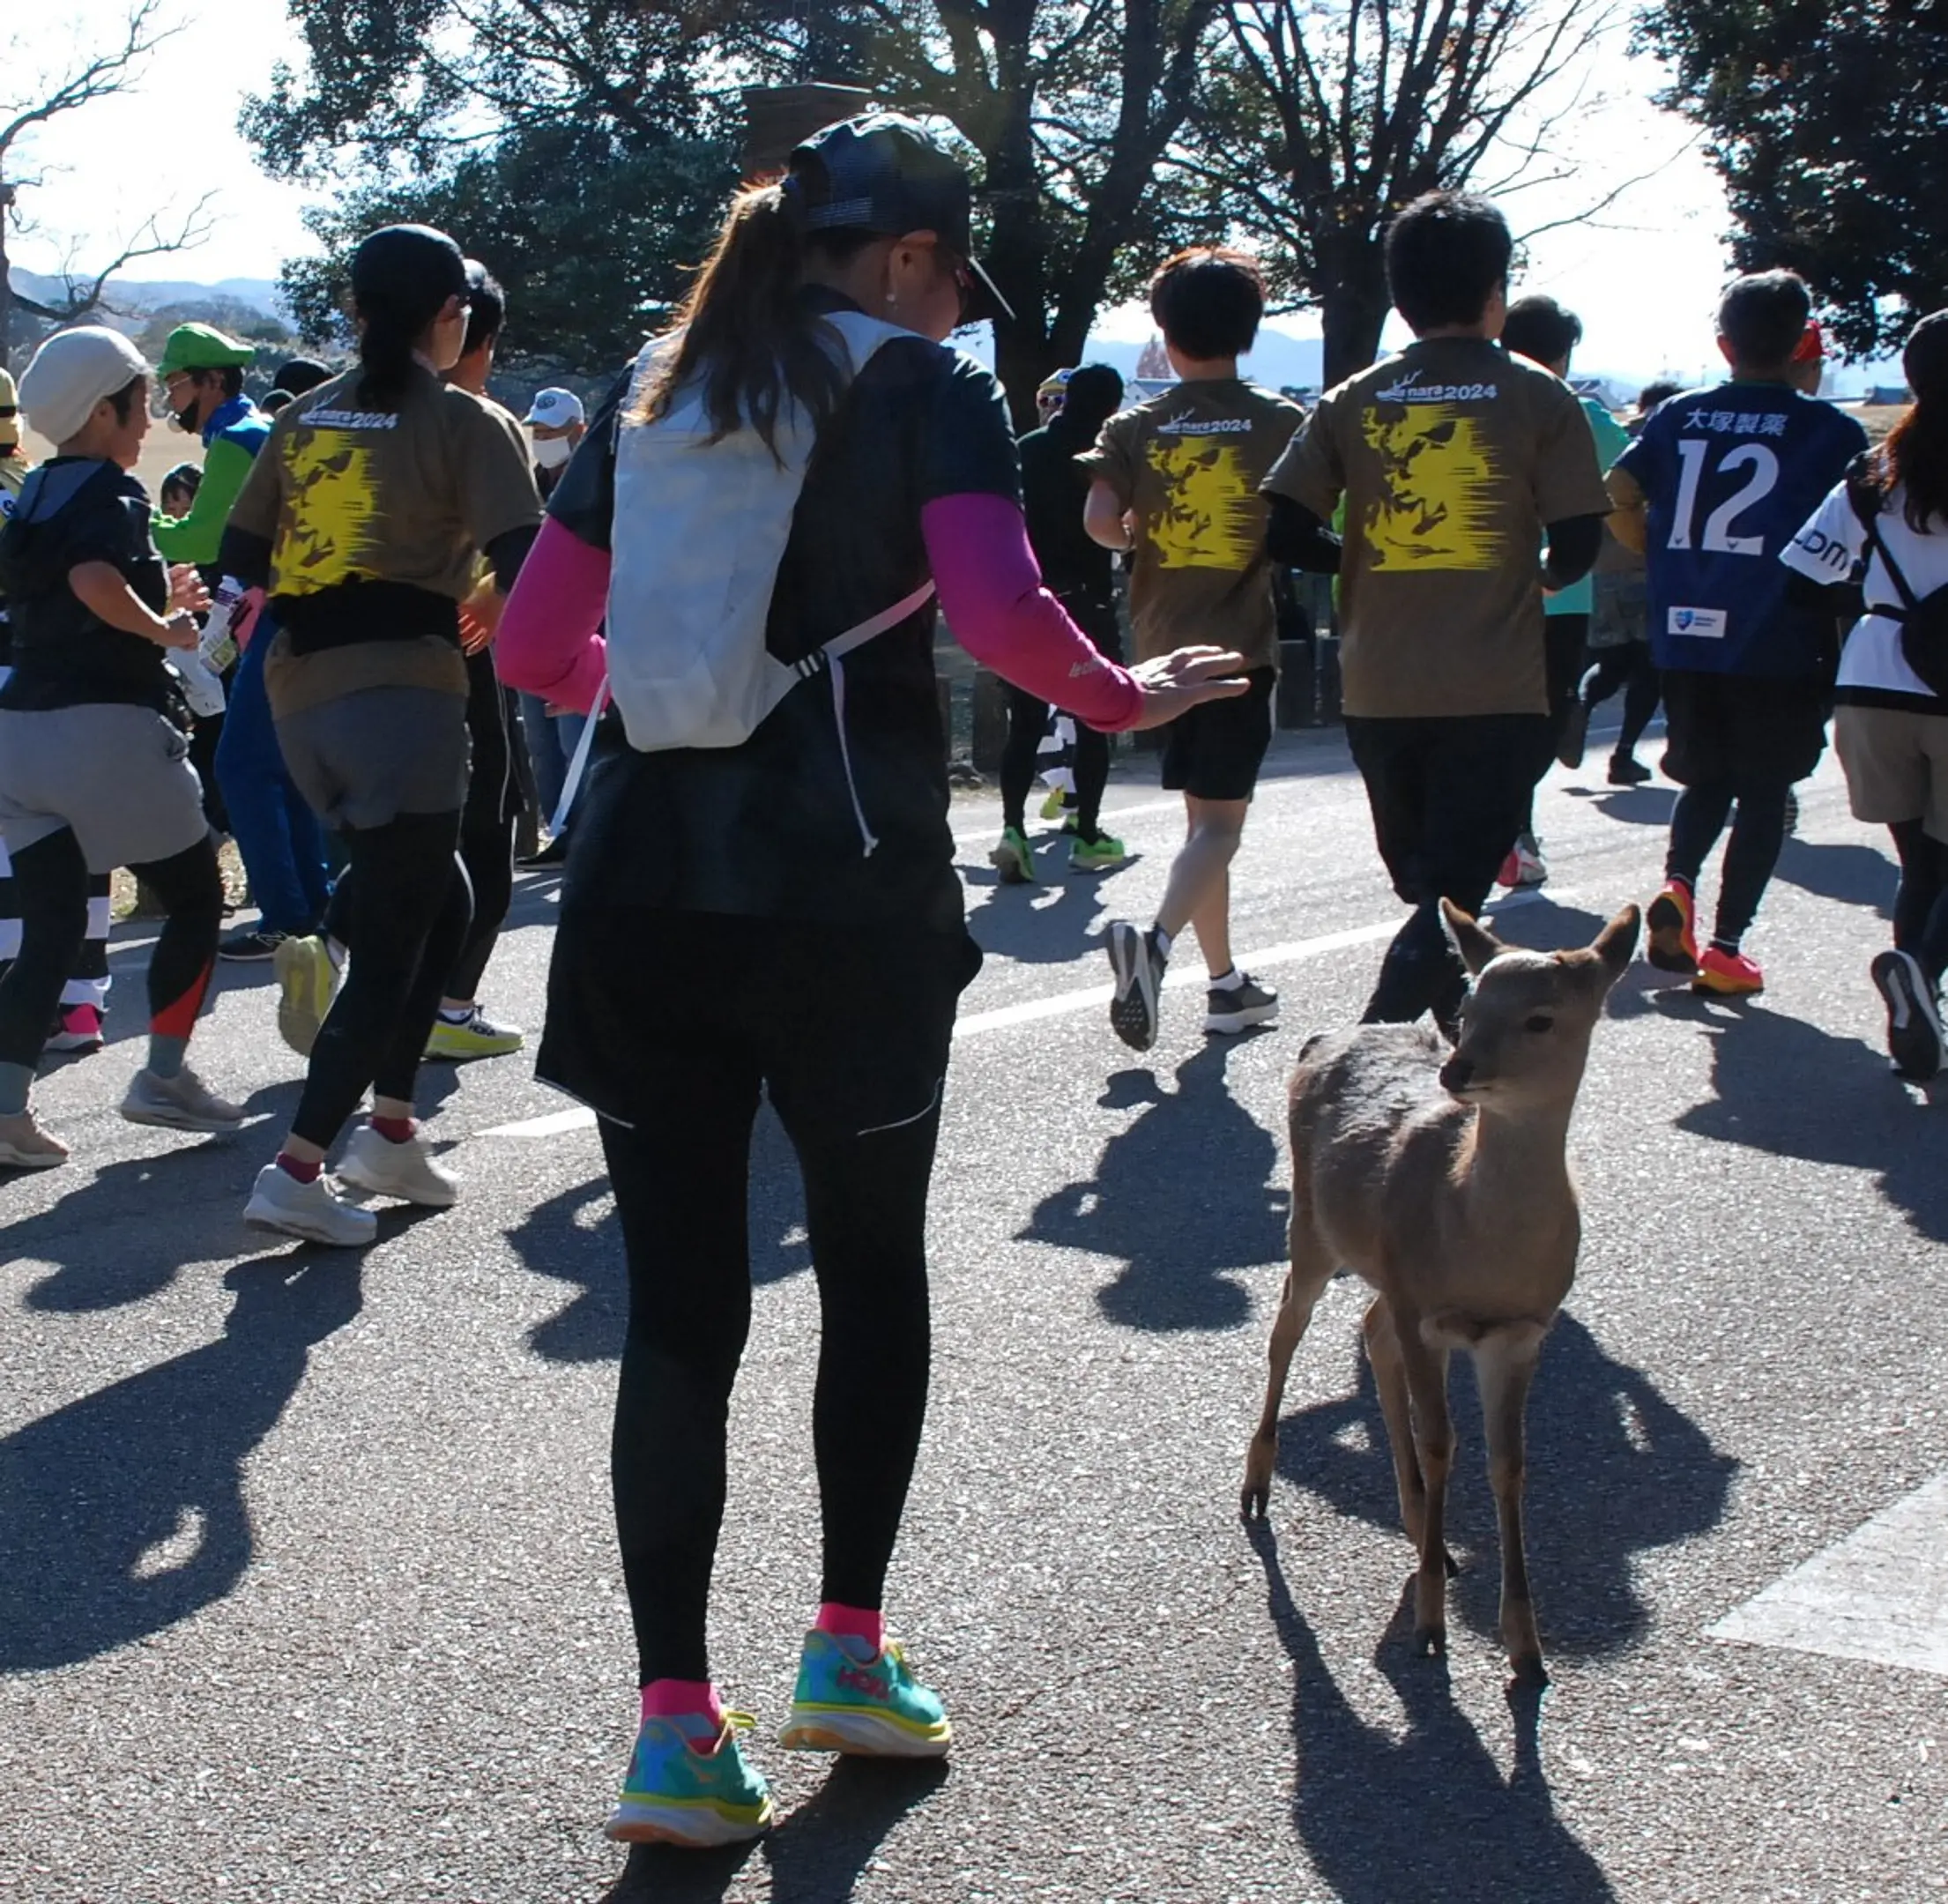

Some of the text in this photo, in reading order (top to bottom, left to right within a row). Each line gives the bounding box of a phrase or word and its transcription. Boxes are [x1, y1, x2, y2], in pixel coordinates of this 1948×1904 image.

[1682, 407, 1788, 436] 大塚製薬
[1667, 439, 1779, 556] 12
